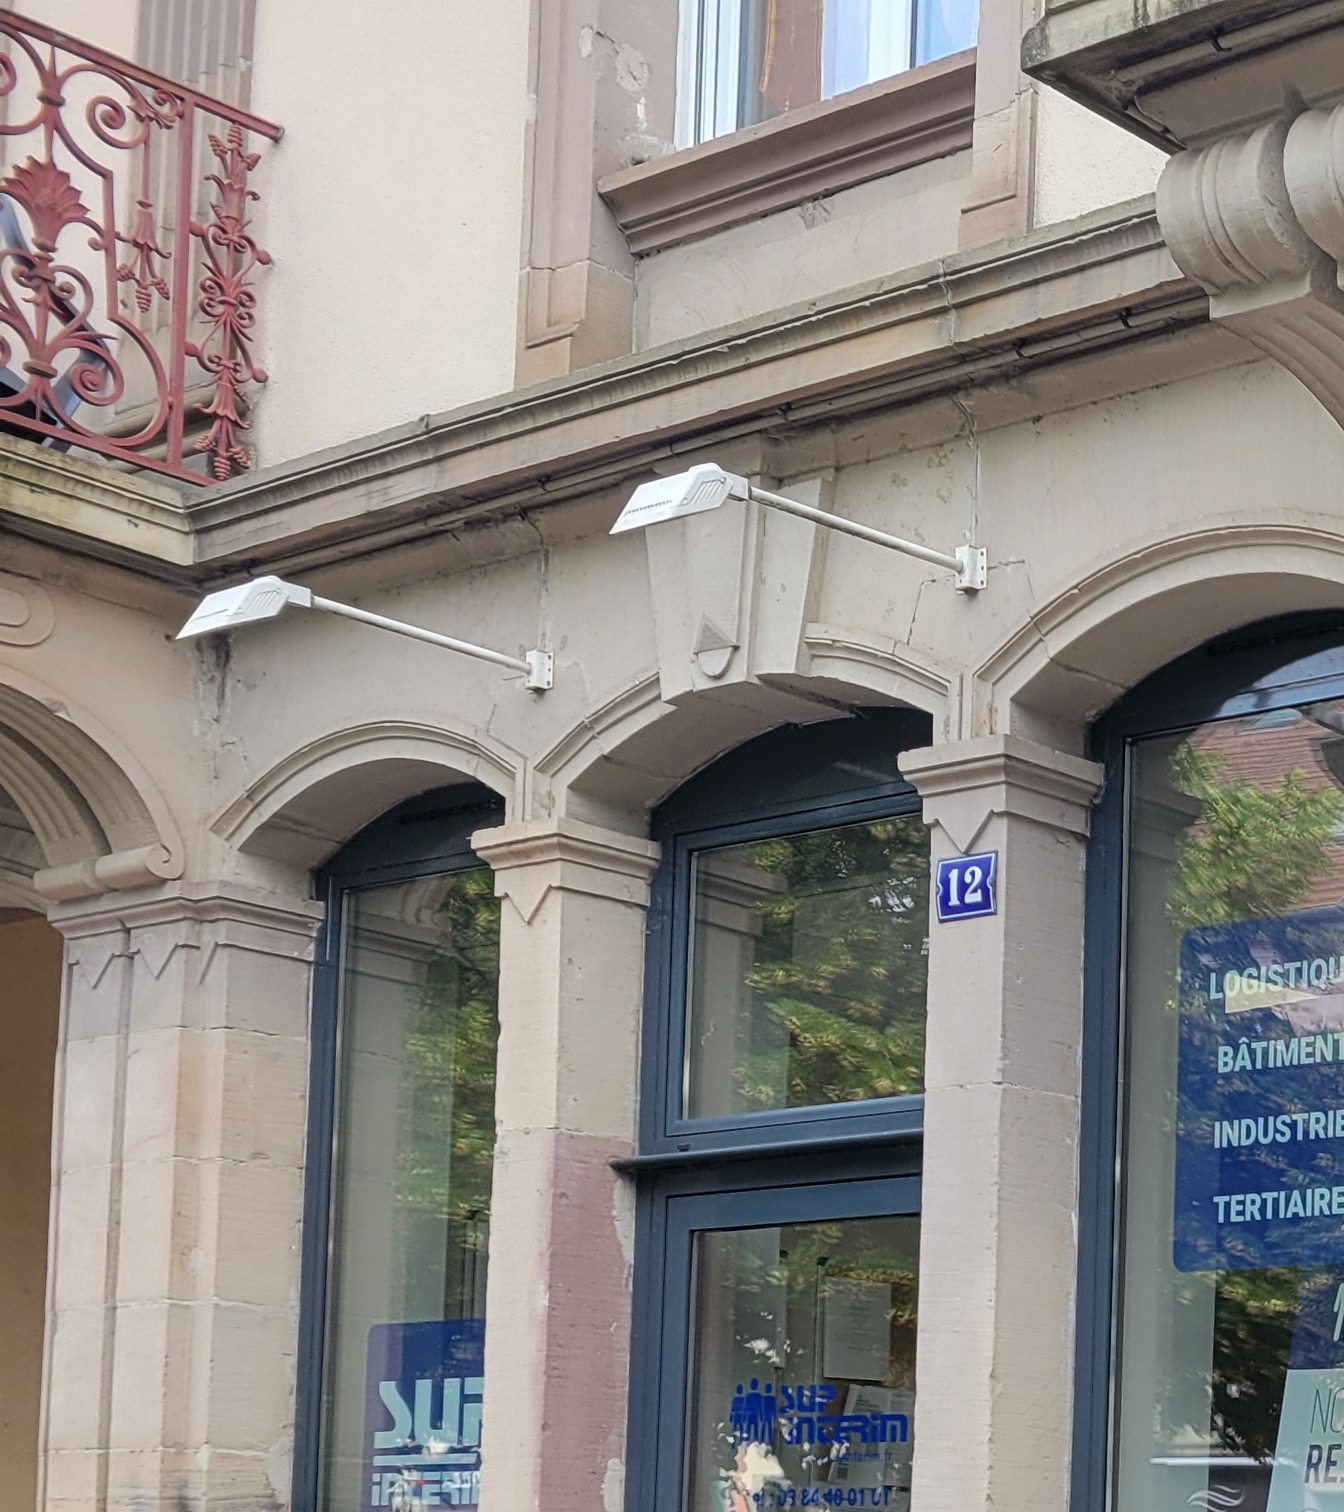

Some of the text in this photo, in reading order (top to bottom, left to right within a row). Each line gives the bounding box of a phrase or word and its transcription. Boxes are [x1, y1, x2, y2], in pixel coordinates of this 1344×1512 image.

[948, 866, 982, 906] 12
[778, 1384, 836, 1414] SUP
[777, 1486, 796, 1507] 03
[802, 1486, 819, 1506] 84
[848, 1486, 866, 1507] 01
